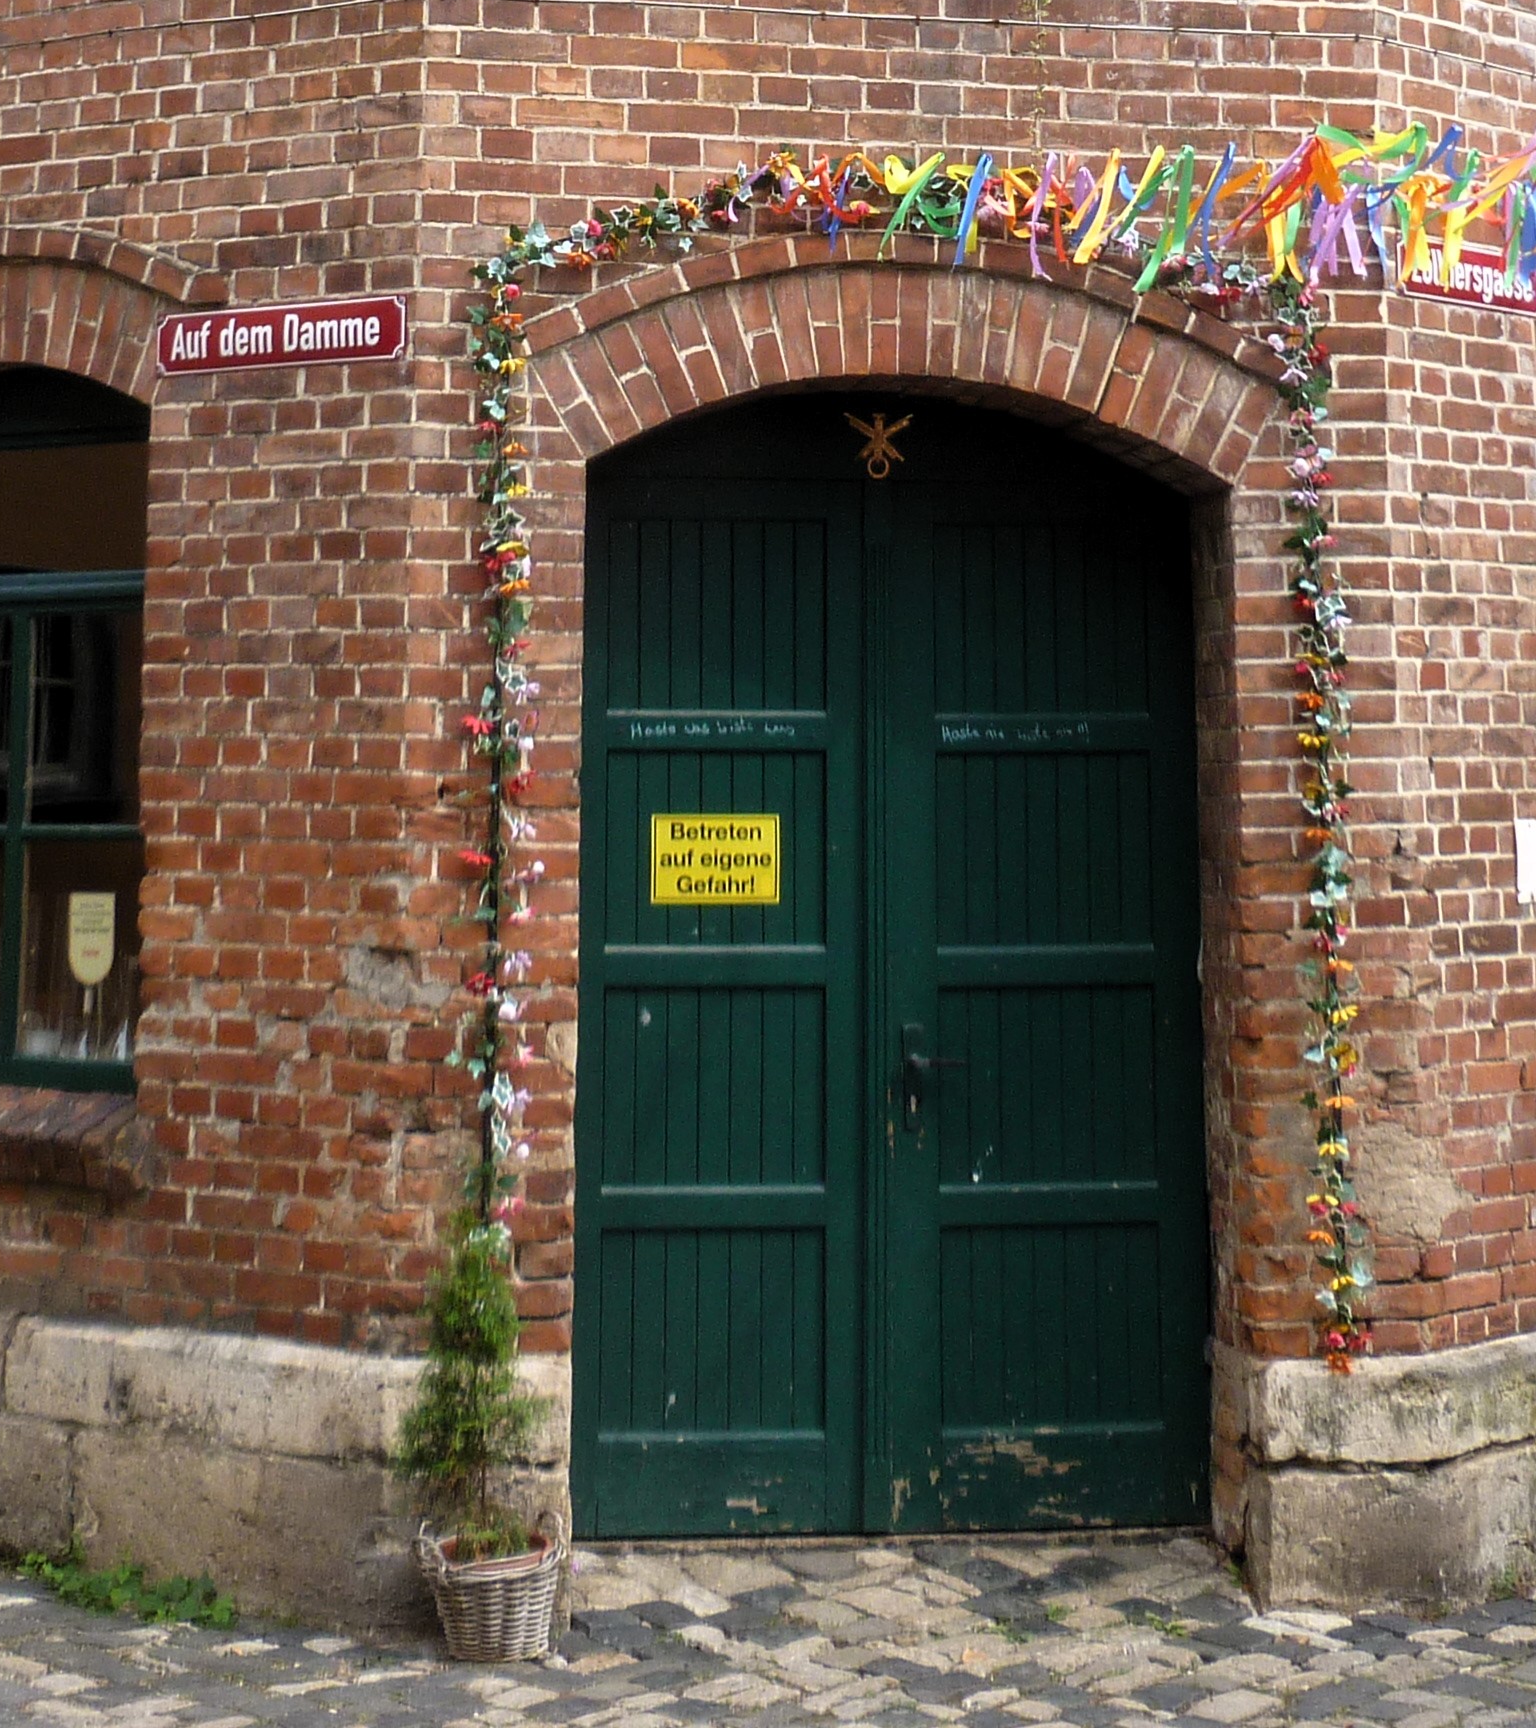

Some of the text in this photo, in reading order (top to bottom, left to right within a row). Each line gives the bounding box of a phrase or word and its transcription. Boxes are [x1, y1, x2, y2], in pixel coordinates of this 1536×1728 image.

[170, 313, 381, 361] Auf dem Damme
[670, 822, 762, 841] Betreten
[660, 849, 772, 871] auf eigene
[677, 875, 755, 894] Gefahr!
